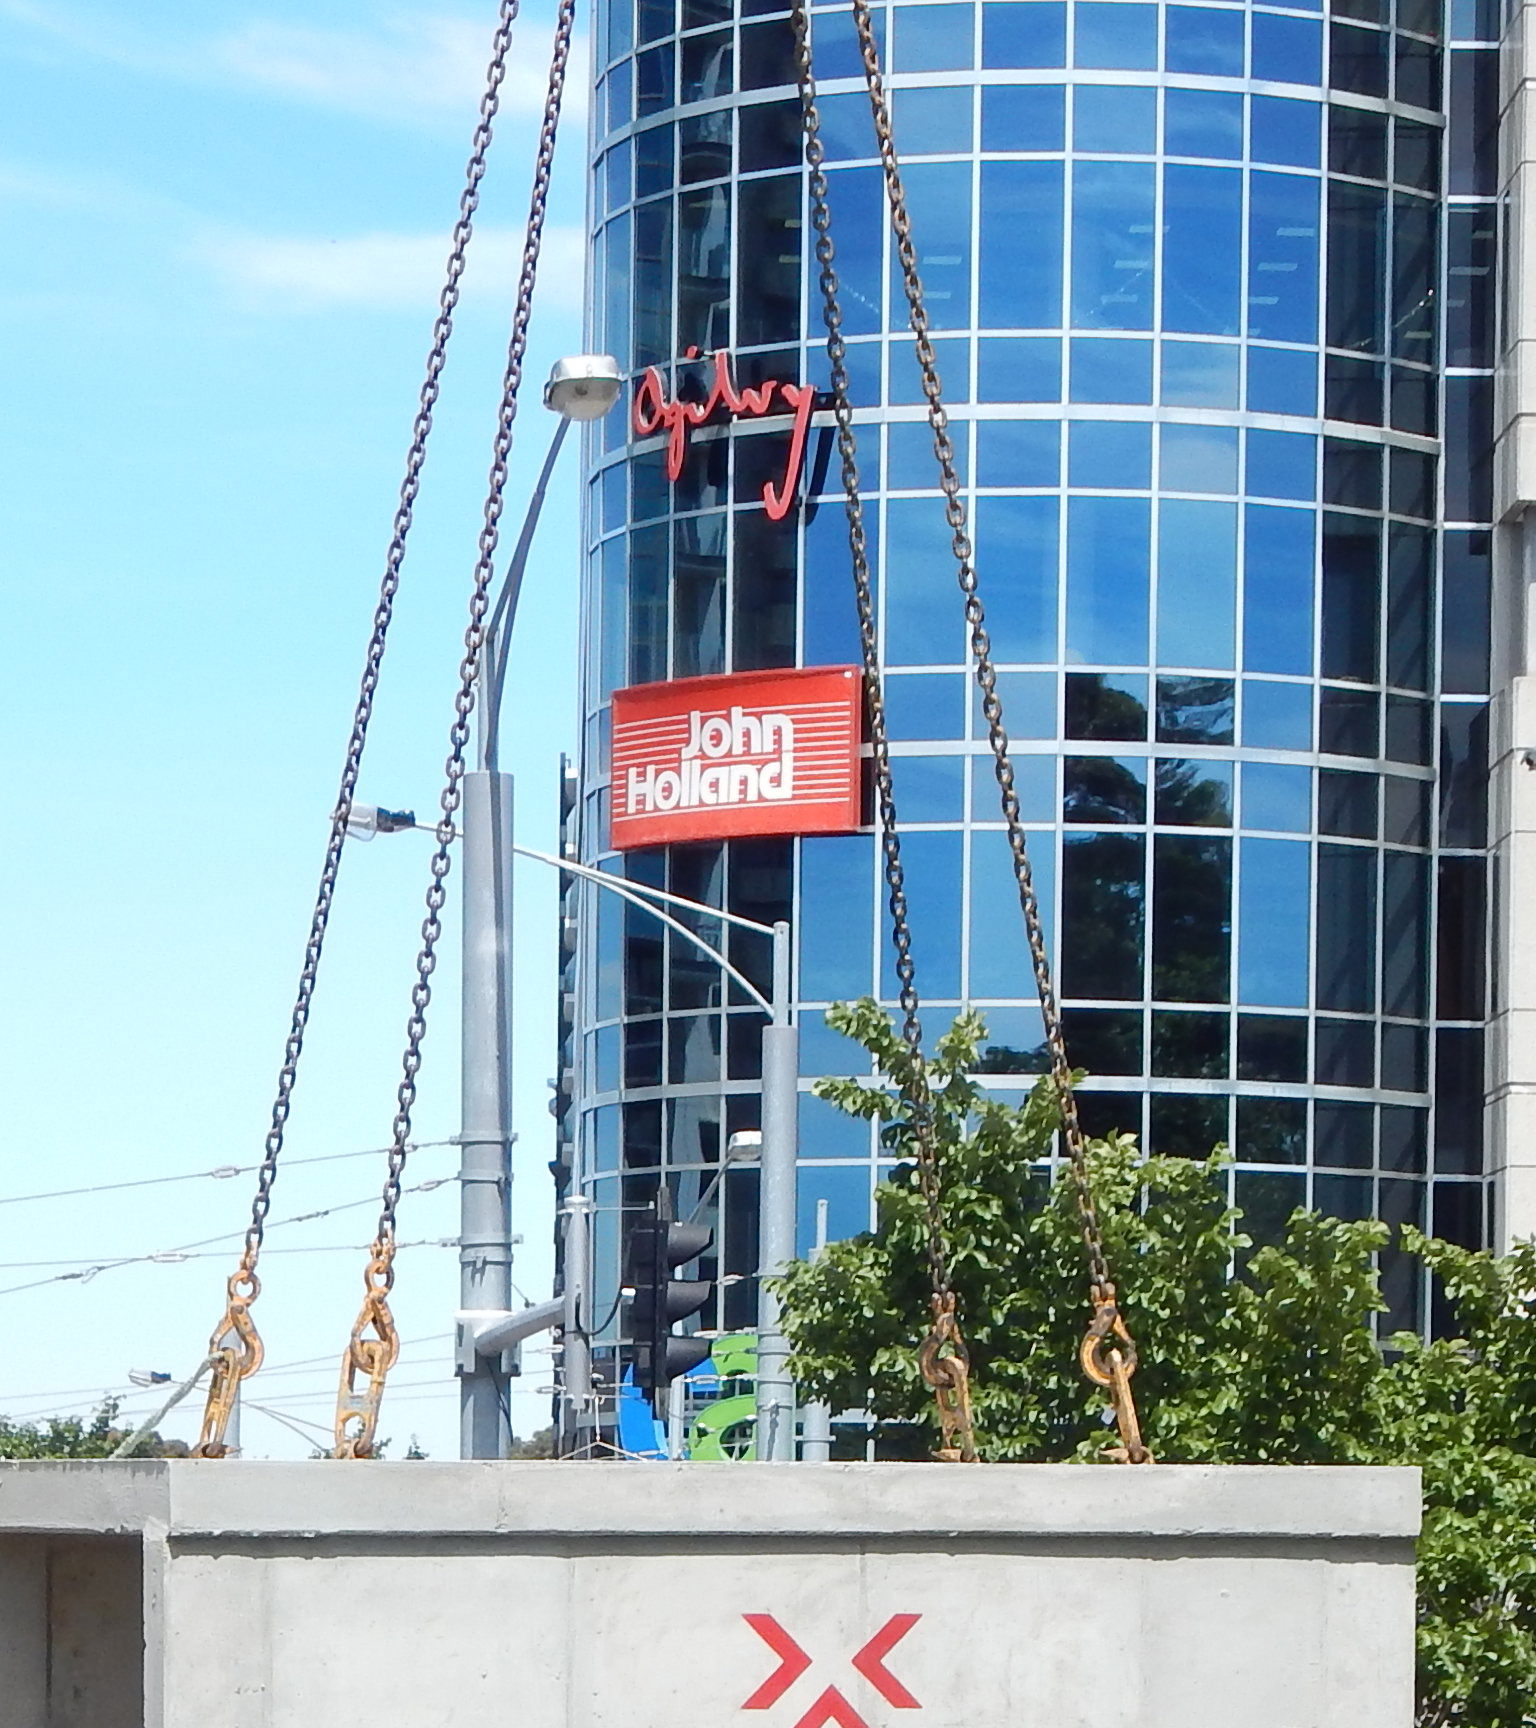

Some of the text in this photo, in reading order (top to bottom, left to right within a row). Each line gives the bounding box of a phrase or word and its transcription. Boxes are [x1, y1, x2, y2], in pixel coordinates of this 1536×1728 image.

[634, 345, 816, 521] Ogilvy
[680, 705, 794, 761] John
[626, 748, 794, 814] Holland
